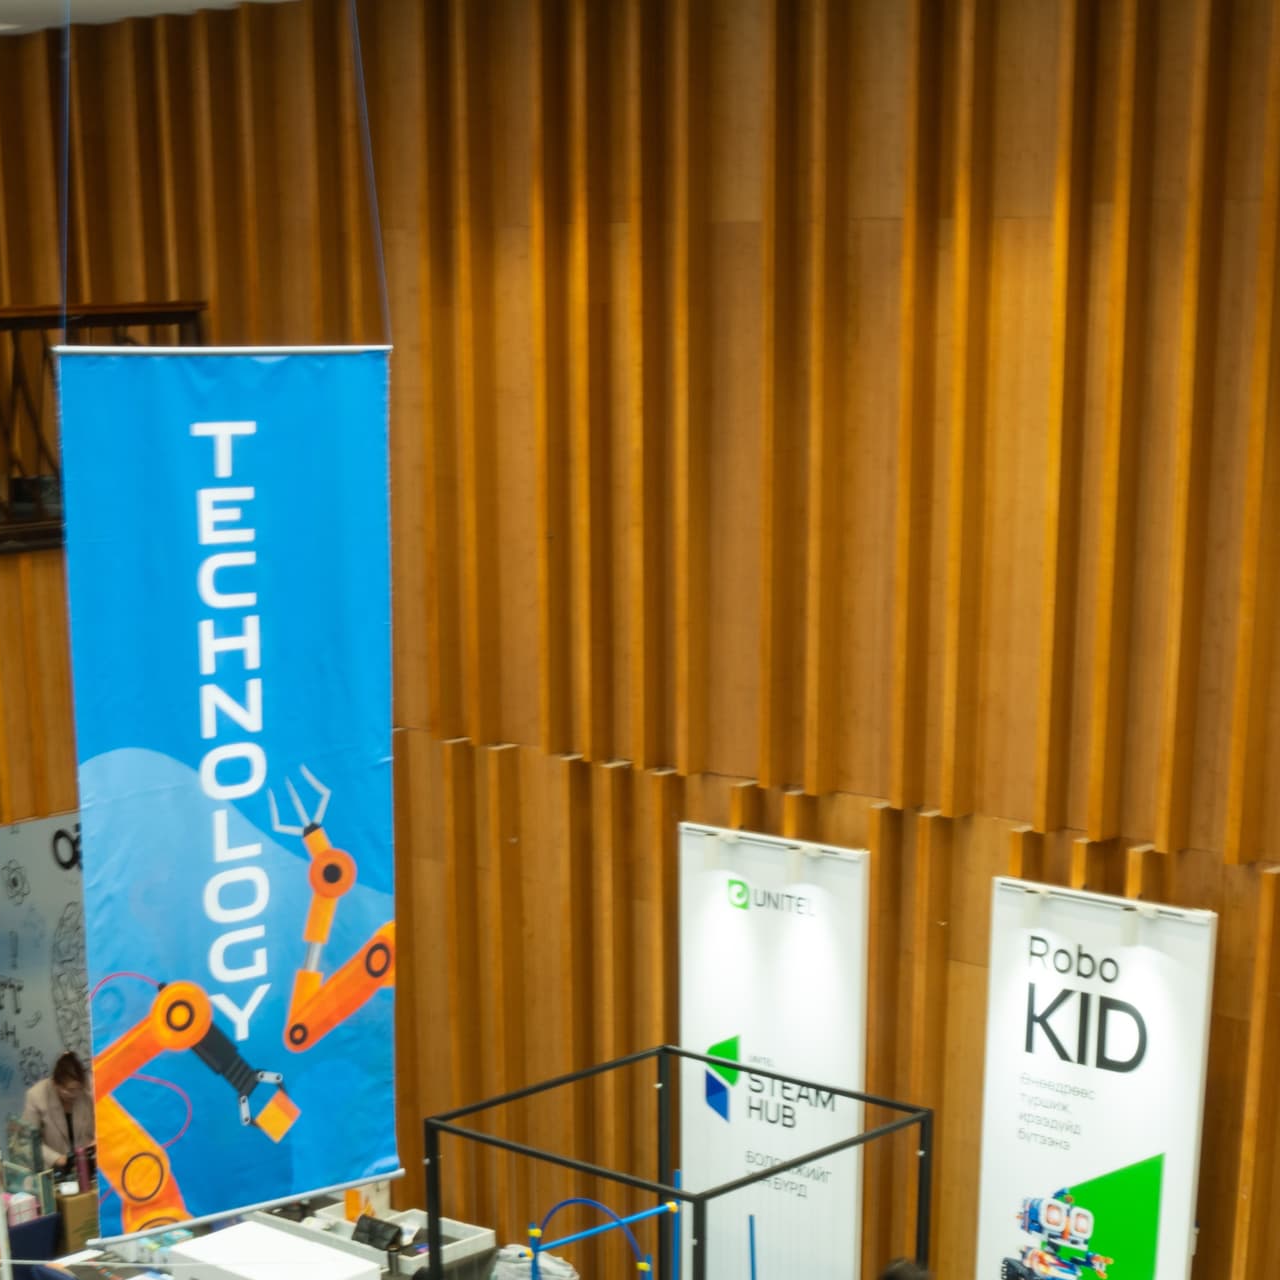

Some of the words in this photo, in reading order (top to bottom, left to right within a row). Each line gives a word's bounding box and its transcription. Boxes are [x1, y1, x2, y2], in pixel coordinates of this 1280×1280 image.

[190, 421, 271, 1041] TECHNOLOGY
[1029, 936, 1119, 983] Robo
[1025, 982, 1147, 1073] KID
[748, 1097, 796, 1129] HUB
